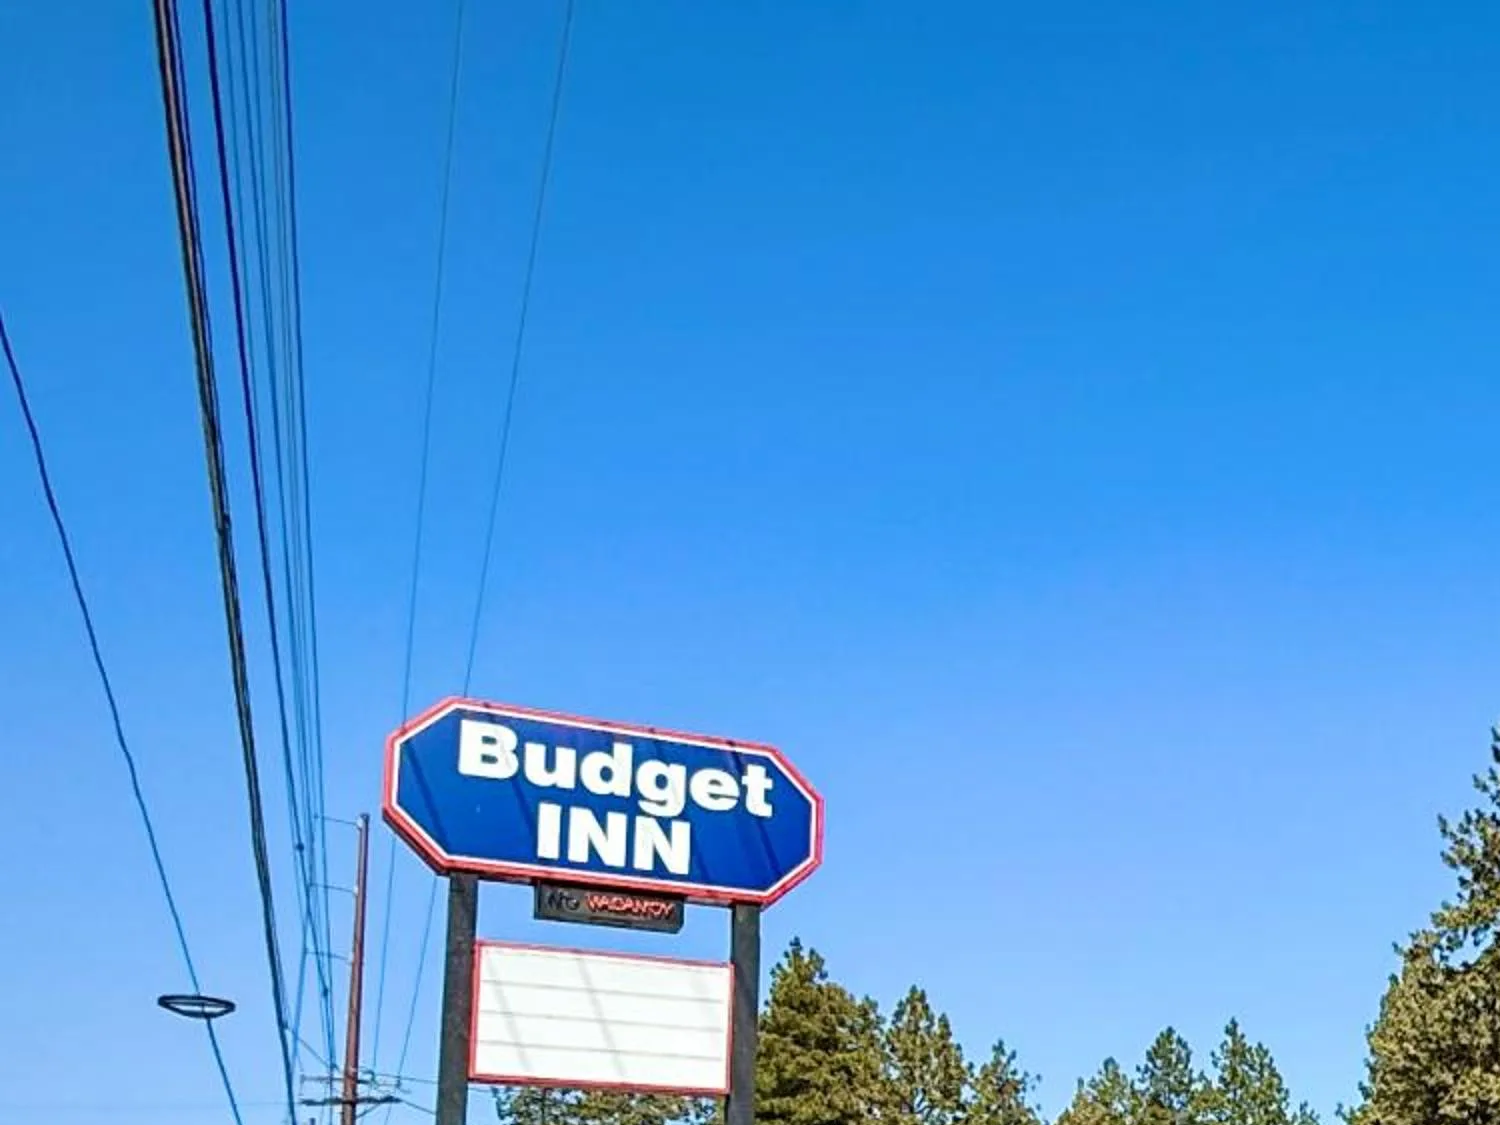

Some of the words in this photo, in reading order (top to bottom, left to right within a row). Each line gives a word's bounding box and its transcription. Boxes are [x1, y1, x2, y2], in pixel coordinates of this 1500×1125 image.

[458, 719, 774, 817] Budget
[537, 803, 691, 875] INN
[586, 893, 675, 918] VACANCY
